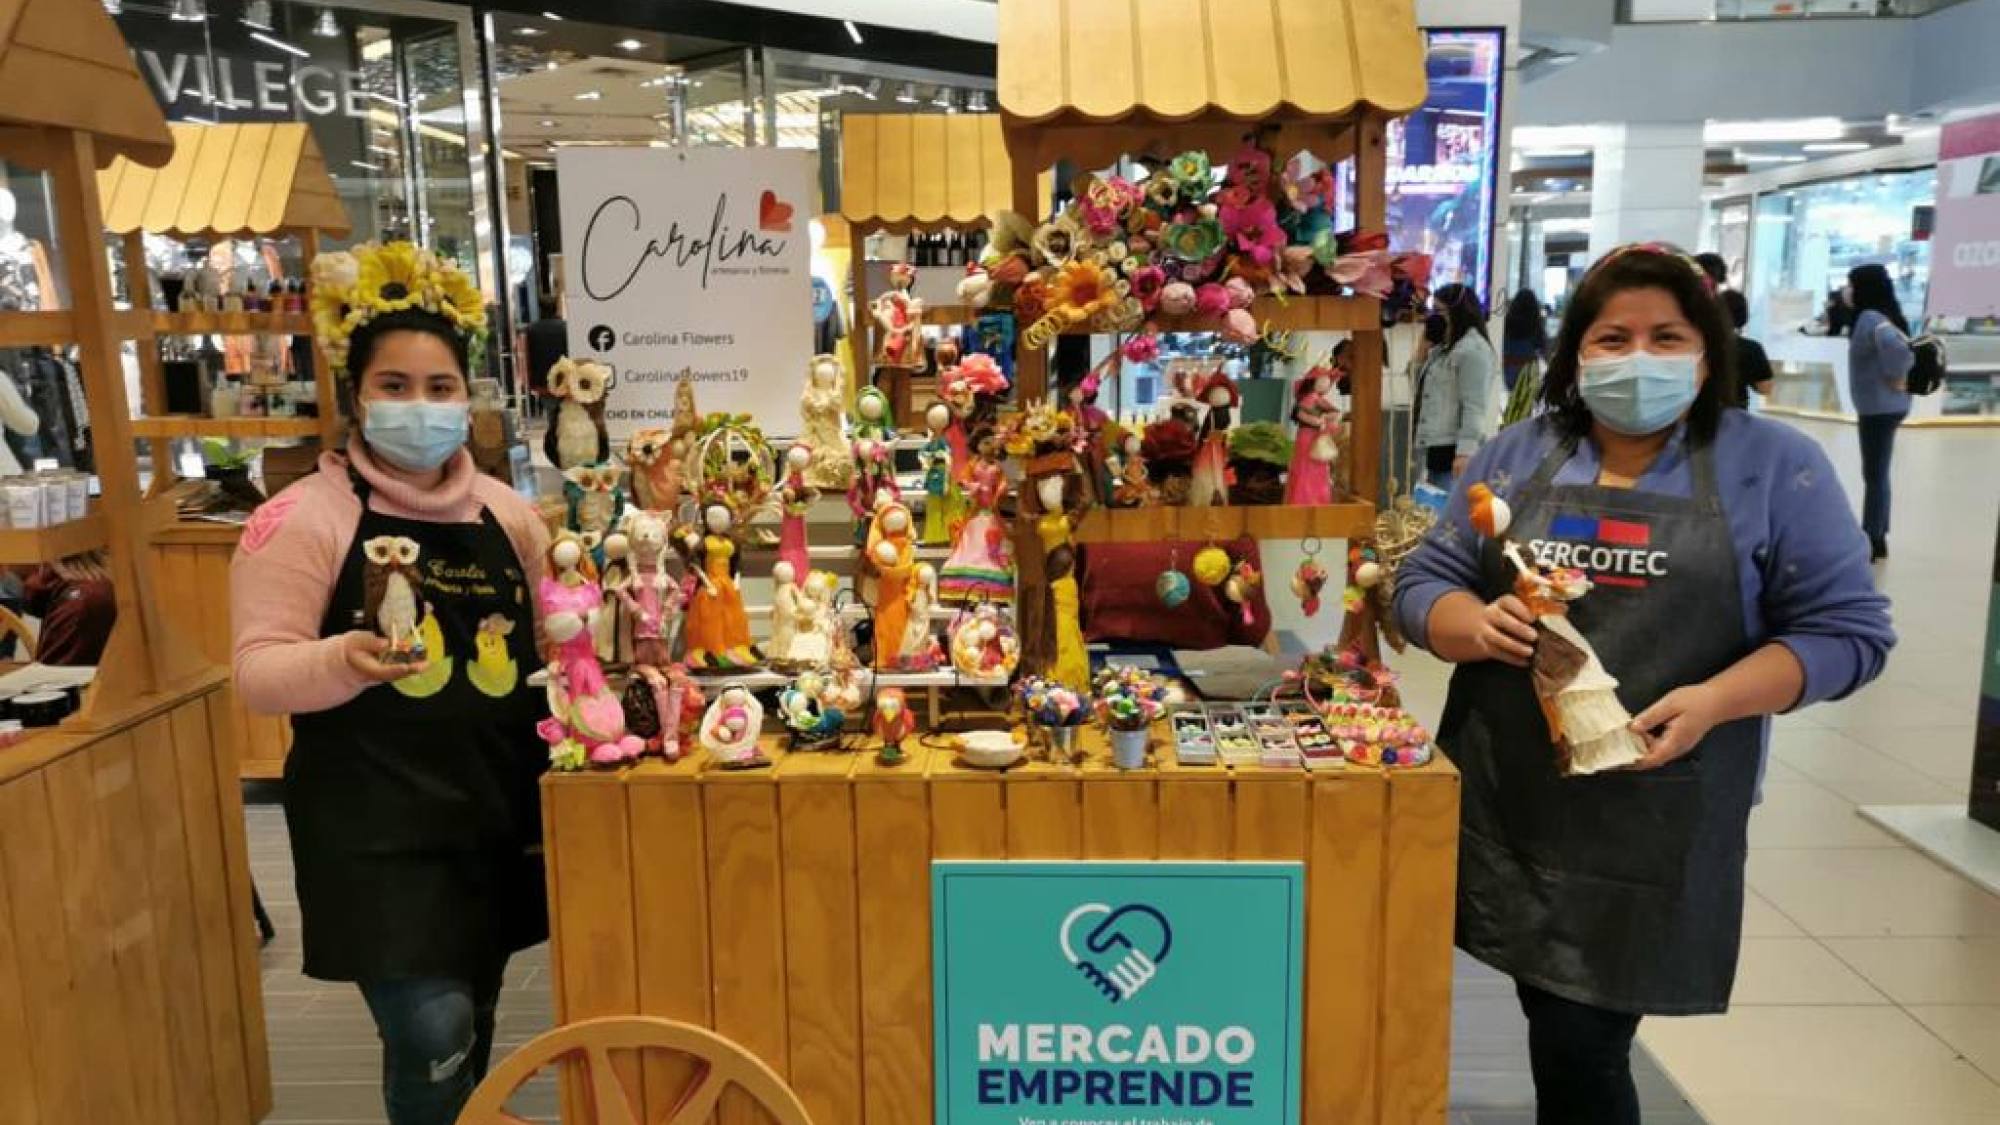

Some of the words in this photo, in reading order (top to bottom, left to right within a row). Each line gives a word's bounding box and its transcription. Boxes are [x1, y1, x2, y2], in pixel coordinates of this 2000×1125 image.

[130, 49, 370, 117] VILEGE
[581, 192, 786, 301] Carolina
[622, 331, 678, 346] Carolina
[683, 331, 735, 346] Flowers
[607, 409, 628, 420] CHO
[1528, 538, 1669, 576] SERCOTEC
[978, 1023, 1256, 1064] MERCADO
[977, 1068, 1255, 1107] EMPRENDE
